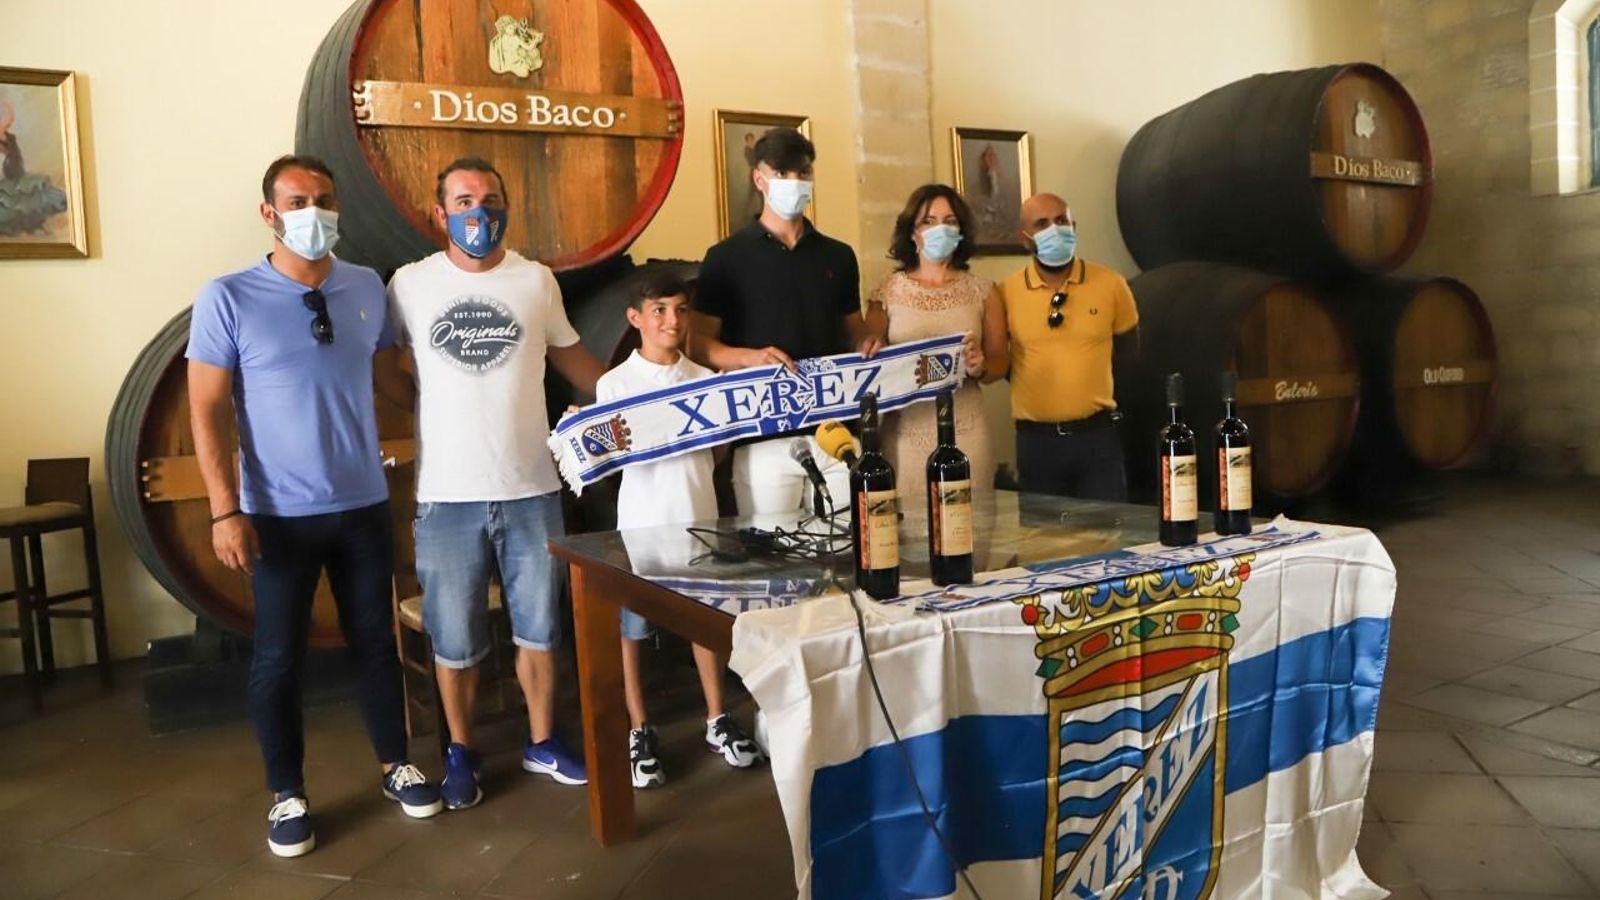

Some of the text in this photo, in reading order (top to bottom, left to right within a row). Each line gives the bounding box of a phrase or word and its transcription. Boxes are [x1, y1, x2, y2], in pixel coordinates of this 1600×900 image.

[429, 89, 615, 128] Dios Baco
[1333, 155, 1404, 180] Dios Baco
[431, 320, 518, 349] Originals
[460, 348, 489, 356] BRAND
[669, 364, 883, 437] XEREZ
